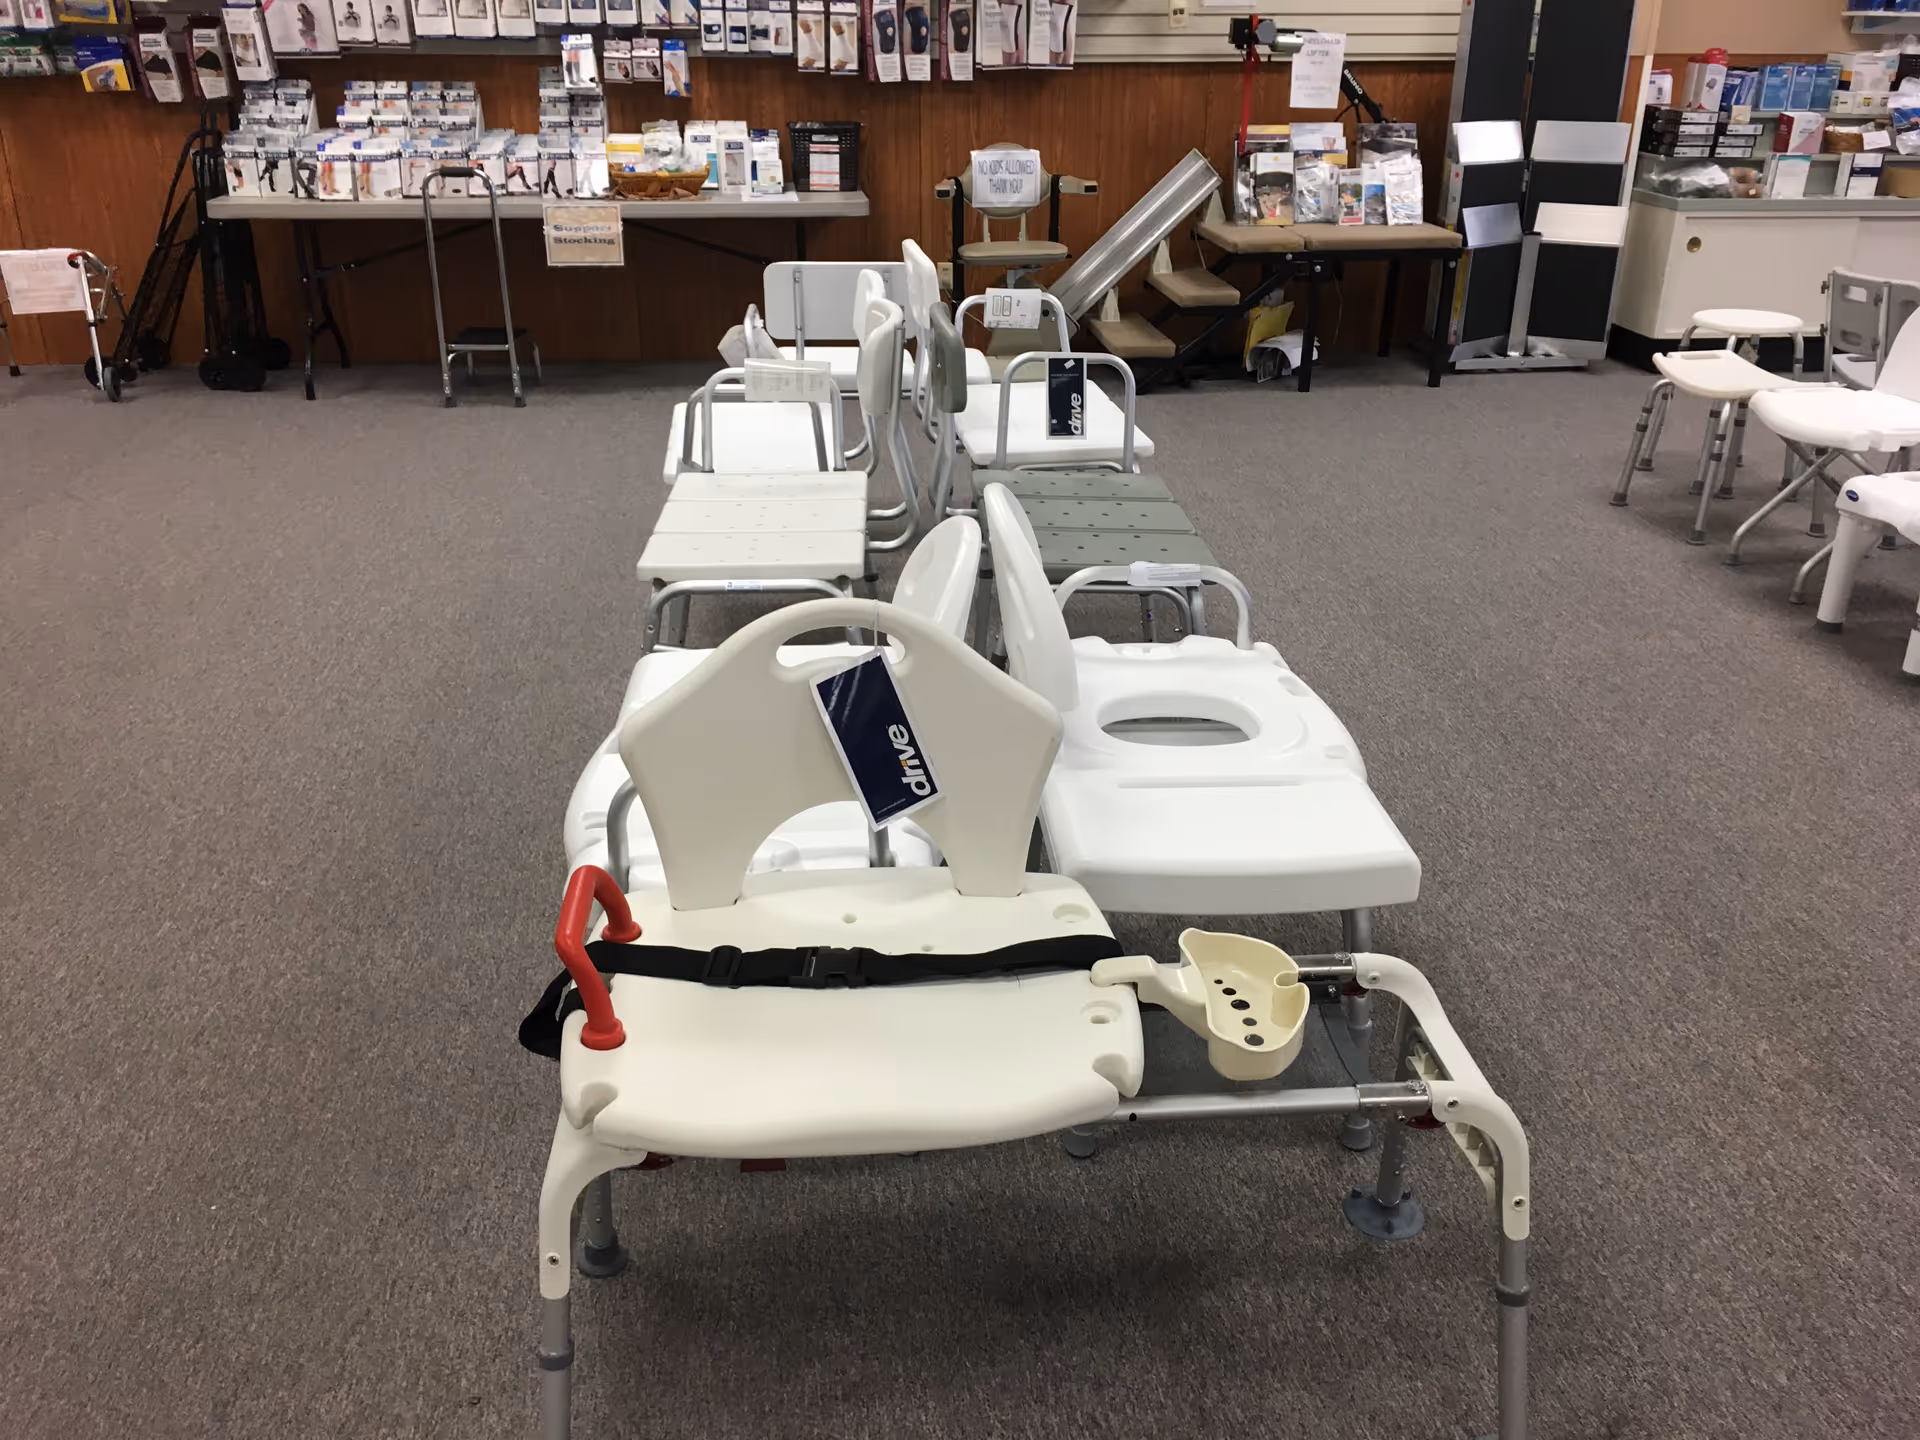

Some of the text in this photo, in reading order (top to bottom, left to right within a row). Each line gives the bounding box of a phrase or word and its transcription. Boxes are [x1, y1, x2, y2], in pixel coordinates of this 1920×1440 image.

[1344, 69, 1363, 95] BRUNO
[1005, 159, 1035, 175] ALLOWED
[989, 178, 1007, 194] THANK
[553, 224, 611, 233] Support
[553, 236, 616, 246] Stocking
[1068, 392, 1082, 436] drive
[888, 723, 931, 797] drive
